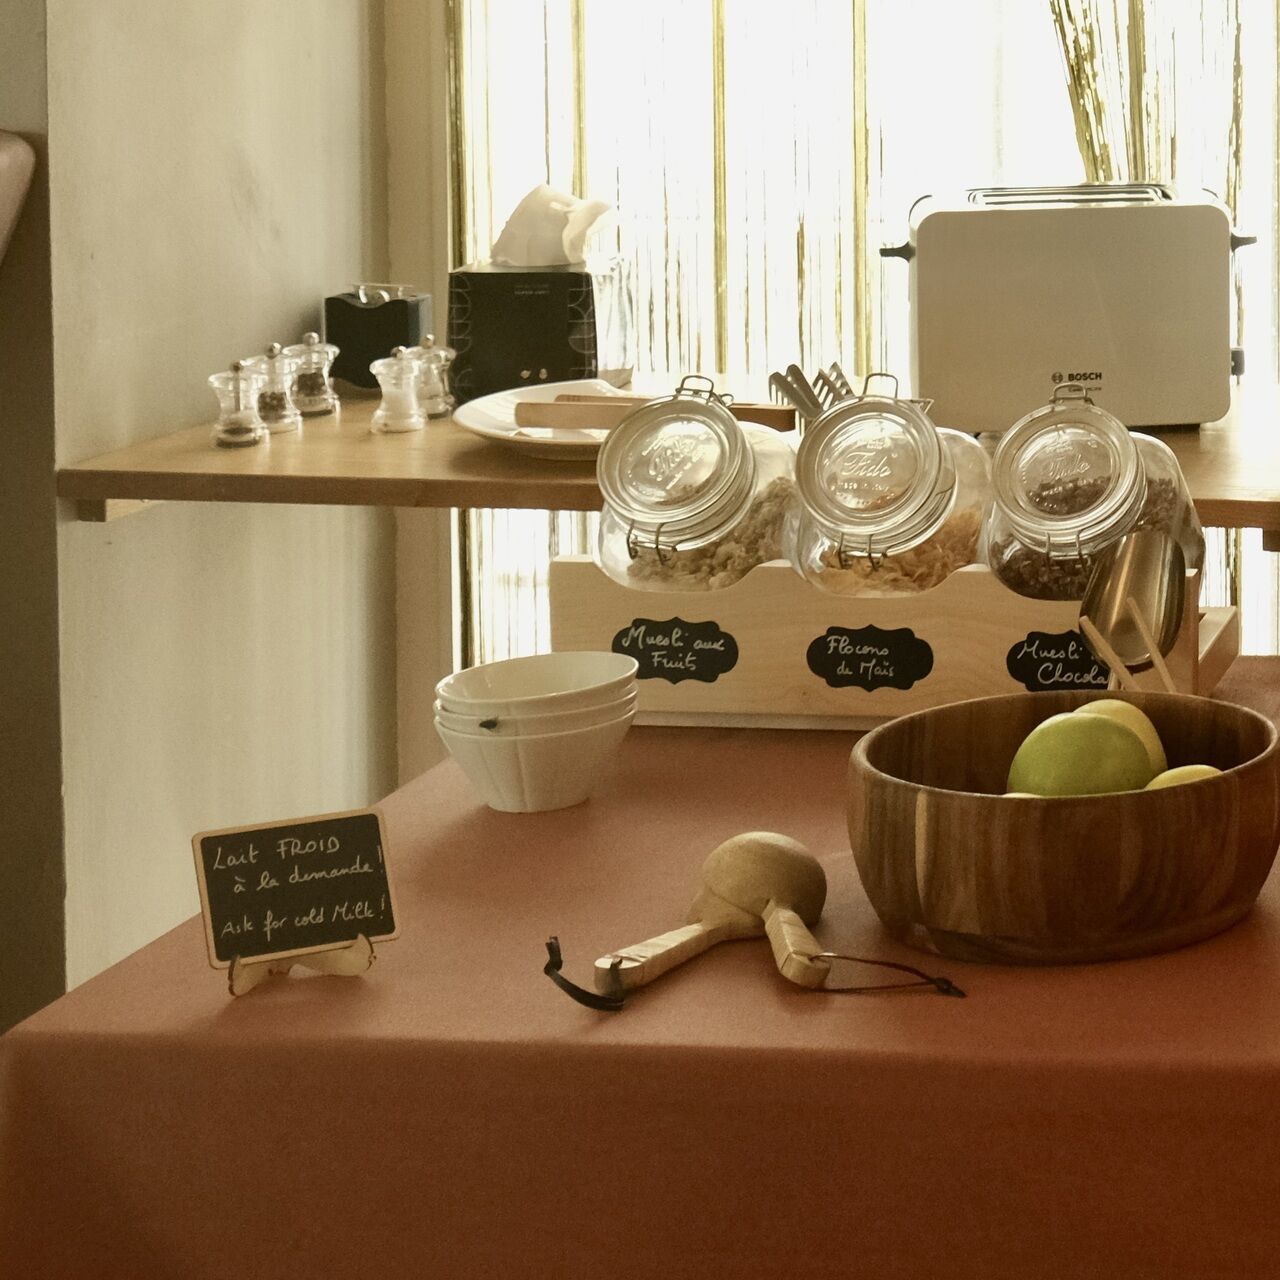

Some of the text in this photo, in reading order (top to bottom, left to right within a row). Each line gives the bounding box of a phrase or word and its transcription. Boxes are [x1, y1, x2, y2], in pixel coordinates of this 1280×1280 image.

[1067, 372, 1102, 382] BOSCH
[651, 651, 697, 671] Fruits
[836, 660, 853, 676] de
[1037, 662, 1109, 685] Chocola
[213, 836, 340, 870] Lait FROID
[233, 876, 246, 894] à
[256, 871, 280, 892] la
[220, 915, 254, 939] Ask
[263, 910, 286, 942] for
[294, 907, 324, 926] cold
